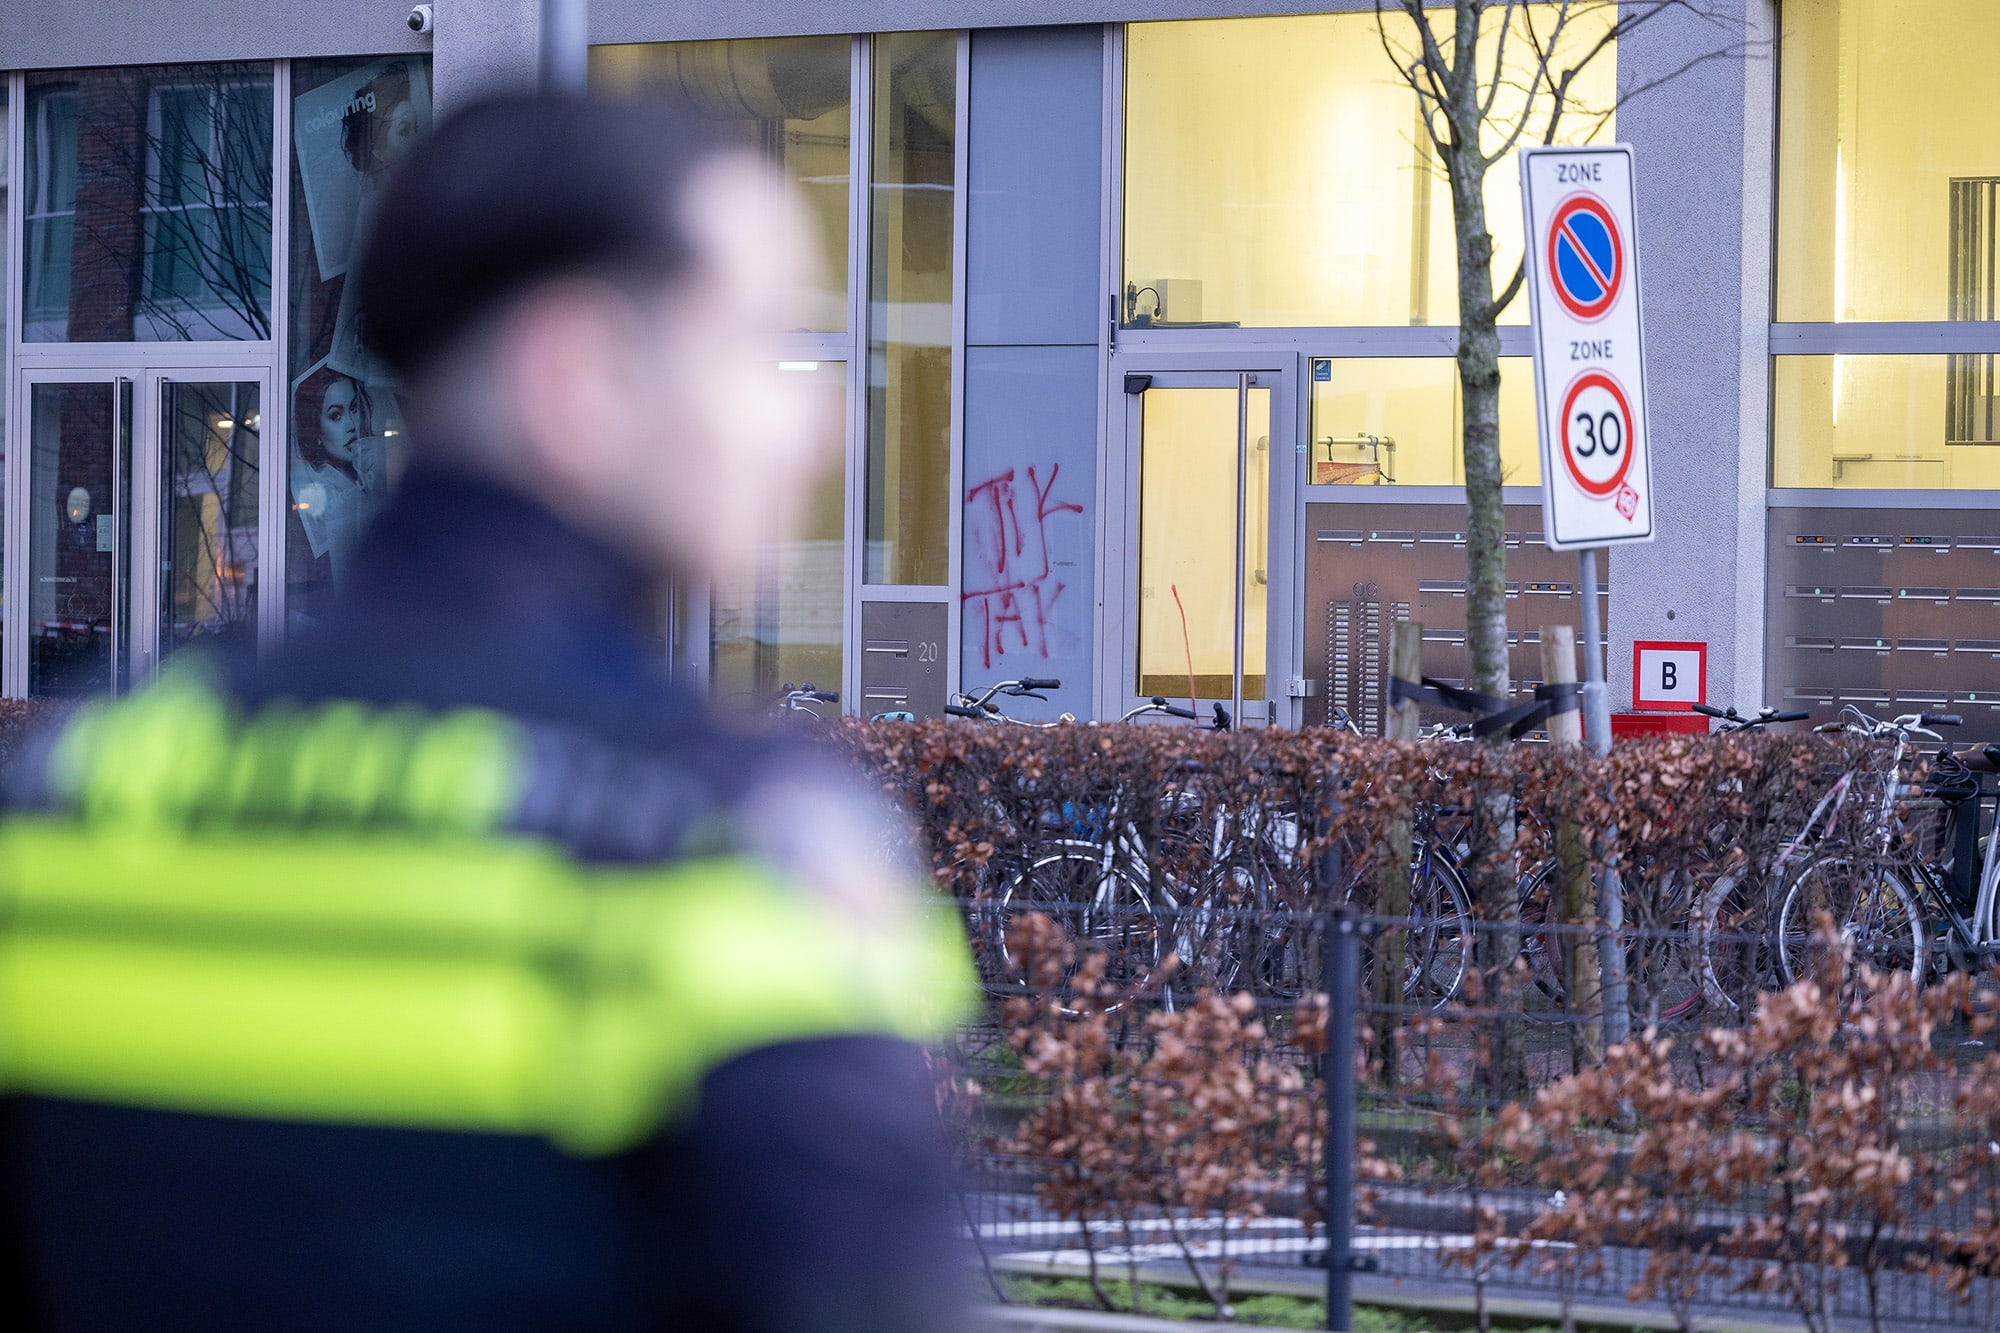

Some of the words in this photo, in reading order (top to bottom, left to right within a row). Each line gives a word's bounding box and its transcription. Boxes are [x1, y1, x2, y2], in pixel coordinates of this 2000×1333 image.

[304, 91, 377, 133] colouring
[1557, 162, 1602, 183] ZONE
[1569, 340, 1614, 360] ZONE
[1575, 411, 1621, 457] 30
[918, 641, 938, 662] 20
[1661, 661, 1677, 690] B
